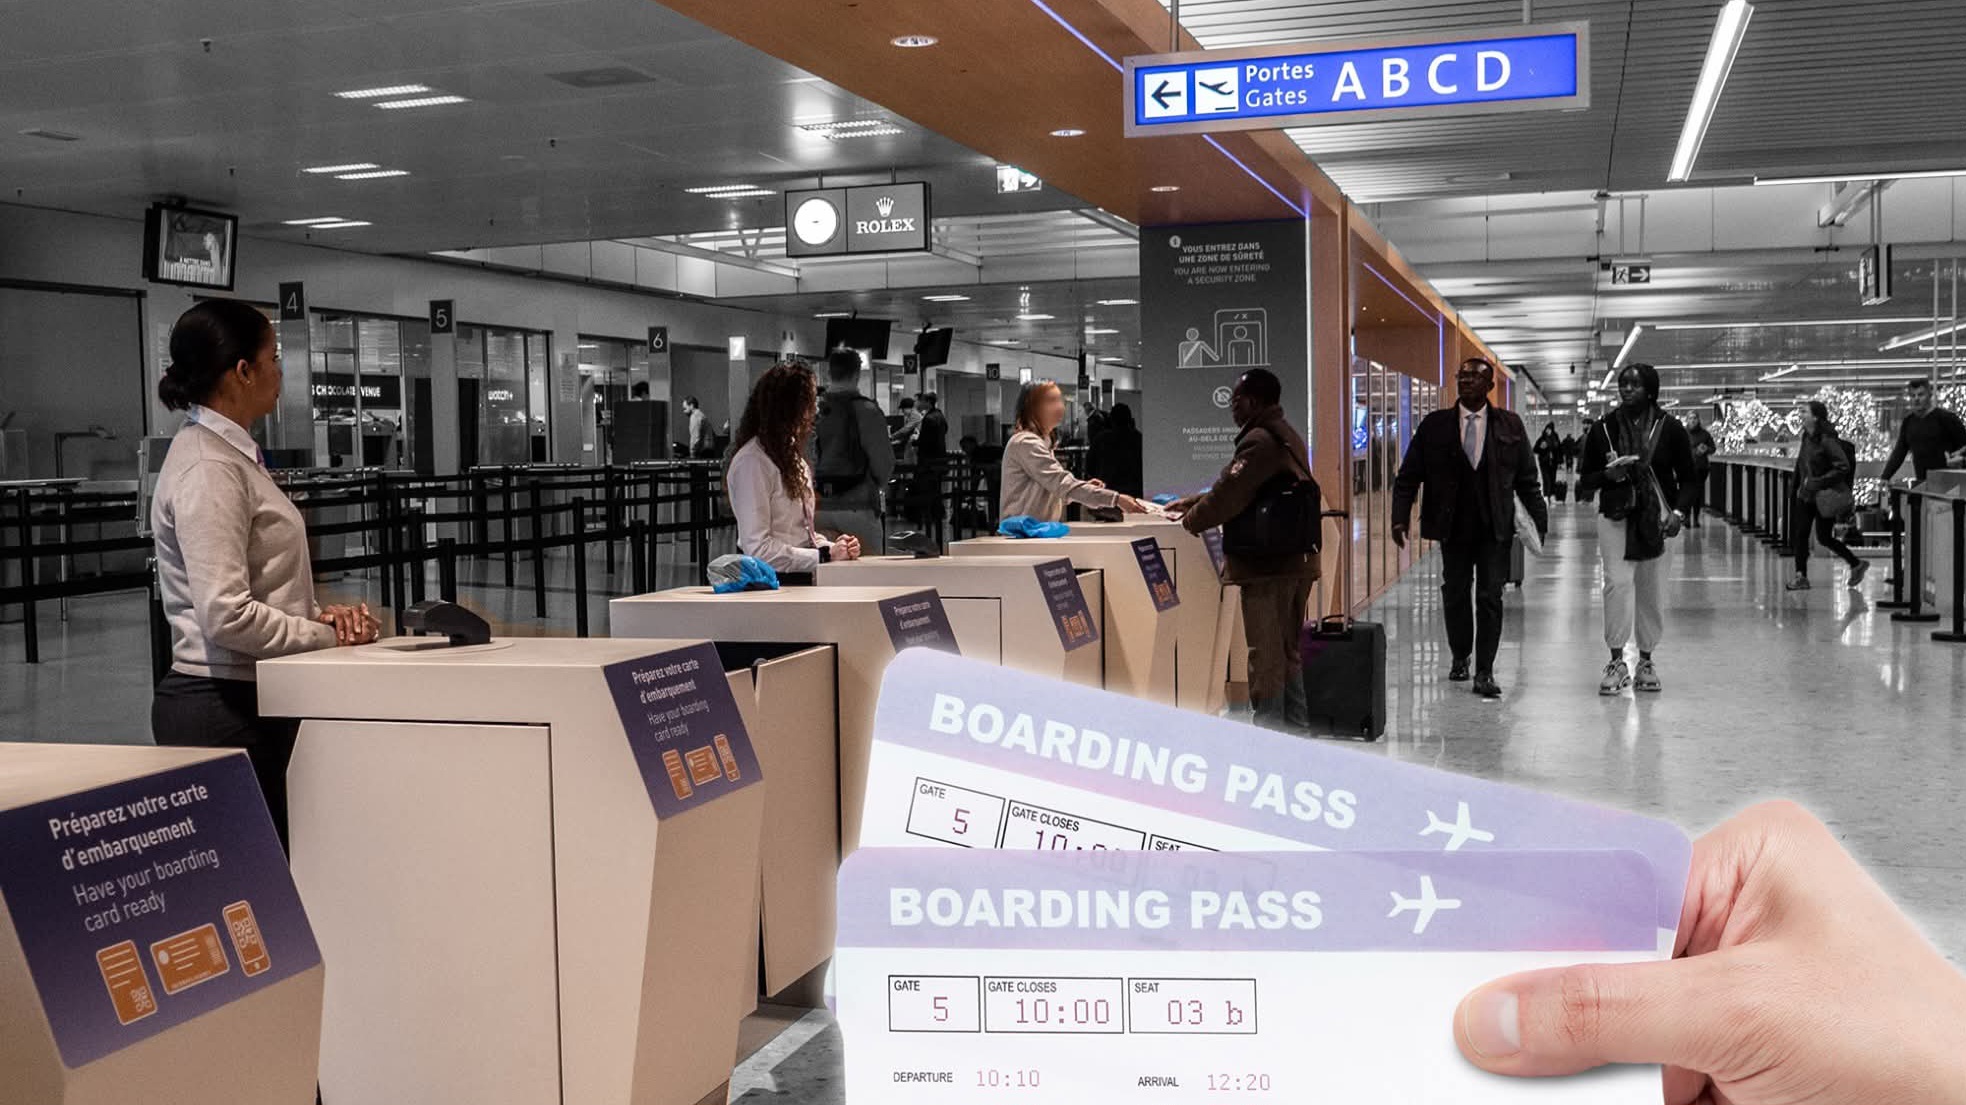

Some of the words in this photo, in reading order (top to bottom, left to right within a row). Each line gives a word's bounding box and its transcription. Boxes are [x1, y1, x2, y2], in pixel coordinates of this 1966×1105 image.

[1245, 63, 1314, 82] Portes
[1332, 61, 1366, 101] A
[1382, 57, 1410, 98] B
[1427, 53, 1457, 94] C
[1476, 50, 1511, 92] D
[1245, 89, 1308, 107] Gates
[856, 218, 915, 234] ROLEX
[1179, 255, 1195, 263] UNE
[1197, 254, 1218, 263] ZONE
[1220, 253, 1231, 261] DE
[1232, 250, 1264, 261] SÛRETÉ
[1182, 245, 1203, 253] VOUS
[1205, 243, 1236, 252] ENTREZ
[1238, 242, 1260, 251] DANS
[1174, 267, 1190, 275] YOU
[1191, 266, 1207, 274] ARE
[1208, 265, 1227, 274] NOW
[1229, 263, 1270, 272] ENTERING
[1187, 277, 1194, 285] A
[1195, 275, 1233, 284] SECURITY
[1234, 274, 1256, 283] ZONE
[286, 291, 298, 313] 4
[436, 308, 448, 328] 5
[652, 333, 664, 349] 6
[632, 669, 665, 684] Préparez
[665, 663, 682, 676] votre
[682, 658, 699, 672] carte
[647, 711, 666, 725] Have
[666, 707, 681, 723] your
[654, 725, 670, 742] card
[670, 722, 690, 737] ready
[929, 693, 1208, 793] BOARDING
[1224, 764, 1357, 829] PASS
[919, 784, 946, 799] GATE
[48, 805, 128, 840] Préparez
[127, 793, 168, 819] votre
[170, 784, 209, 807] carte
[952, 808, 970, 835] 5
[1011, 806, 1038, 823] GATE
[1039, 812, 1080, 832] CLOSES
[61, 816, 197, 870] d'embarquement
[72, 881, 115, 906] Have
[117, 868, 151, 898] your
[152, 849, 220, 881] boarding
[84, 906, 121, 932] card
[123, 890, 167, 918] ready
[890, 887, 1171, 930] BOARDING
[1190, 890, 1323, 930] PASS
[894, 980, 921, 992] GATE
[988, 981, 1014, 993] GATE
[1016, 981, 1057, 993] CLOSES
[1134, 982, 1160, 993] SEAT
[933, 996, 949, 1022] 5
[1015, 998, 1110, 1025] 10:00
[1168, 1000, 1203, 1025] 03
[1226, 1000, 1243, 1025] b
[893, 1072, 953, 1084] DEPARTURE
[976, 1069, 1041, 1088] 10:10
[1137, 1076, 1180, 1088] ARRIVAL
[1207, 1073, 1271, 1092] 12:20
